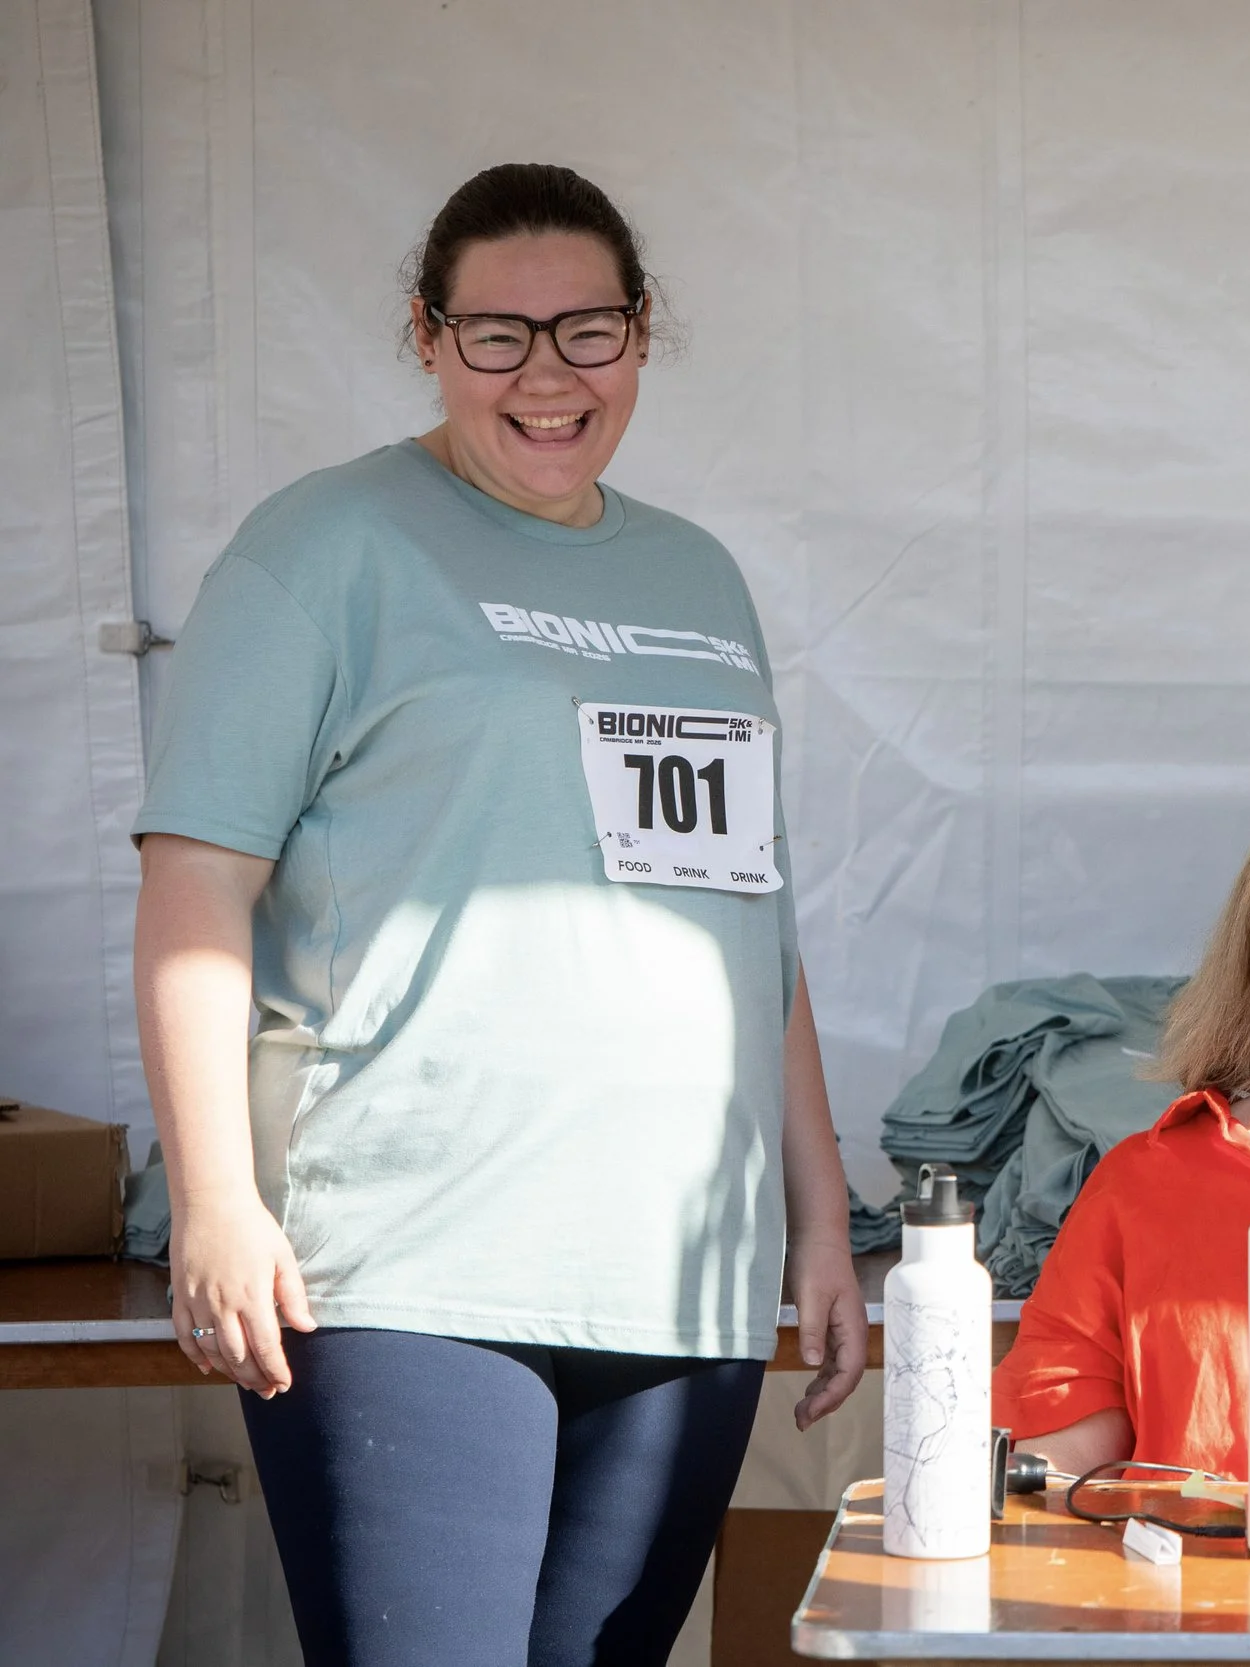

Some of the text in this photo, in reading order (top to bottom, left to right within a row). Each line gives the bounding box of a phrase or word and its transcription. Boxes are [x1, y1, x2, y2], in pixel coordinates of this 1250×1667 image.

[478, 602, 723, 662] BIONIC
[597, 711, 729, 741] BIONIC
[599, 736, 633, 744] CAMBRIDGE
[623, 753, 728, 835] 701
[618, 860, 769, 884] FOOD DRINK DRINK
